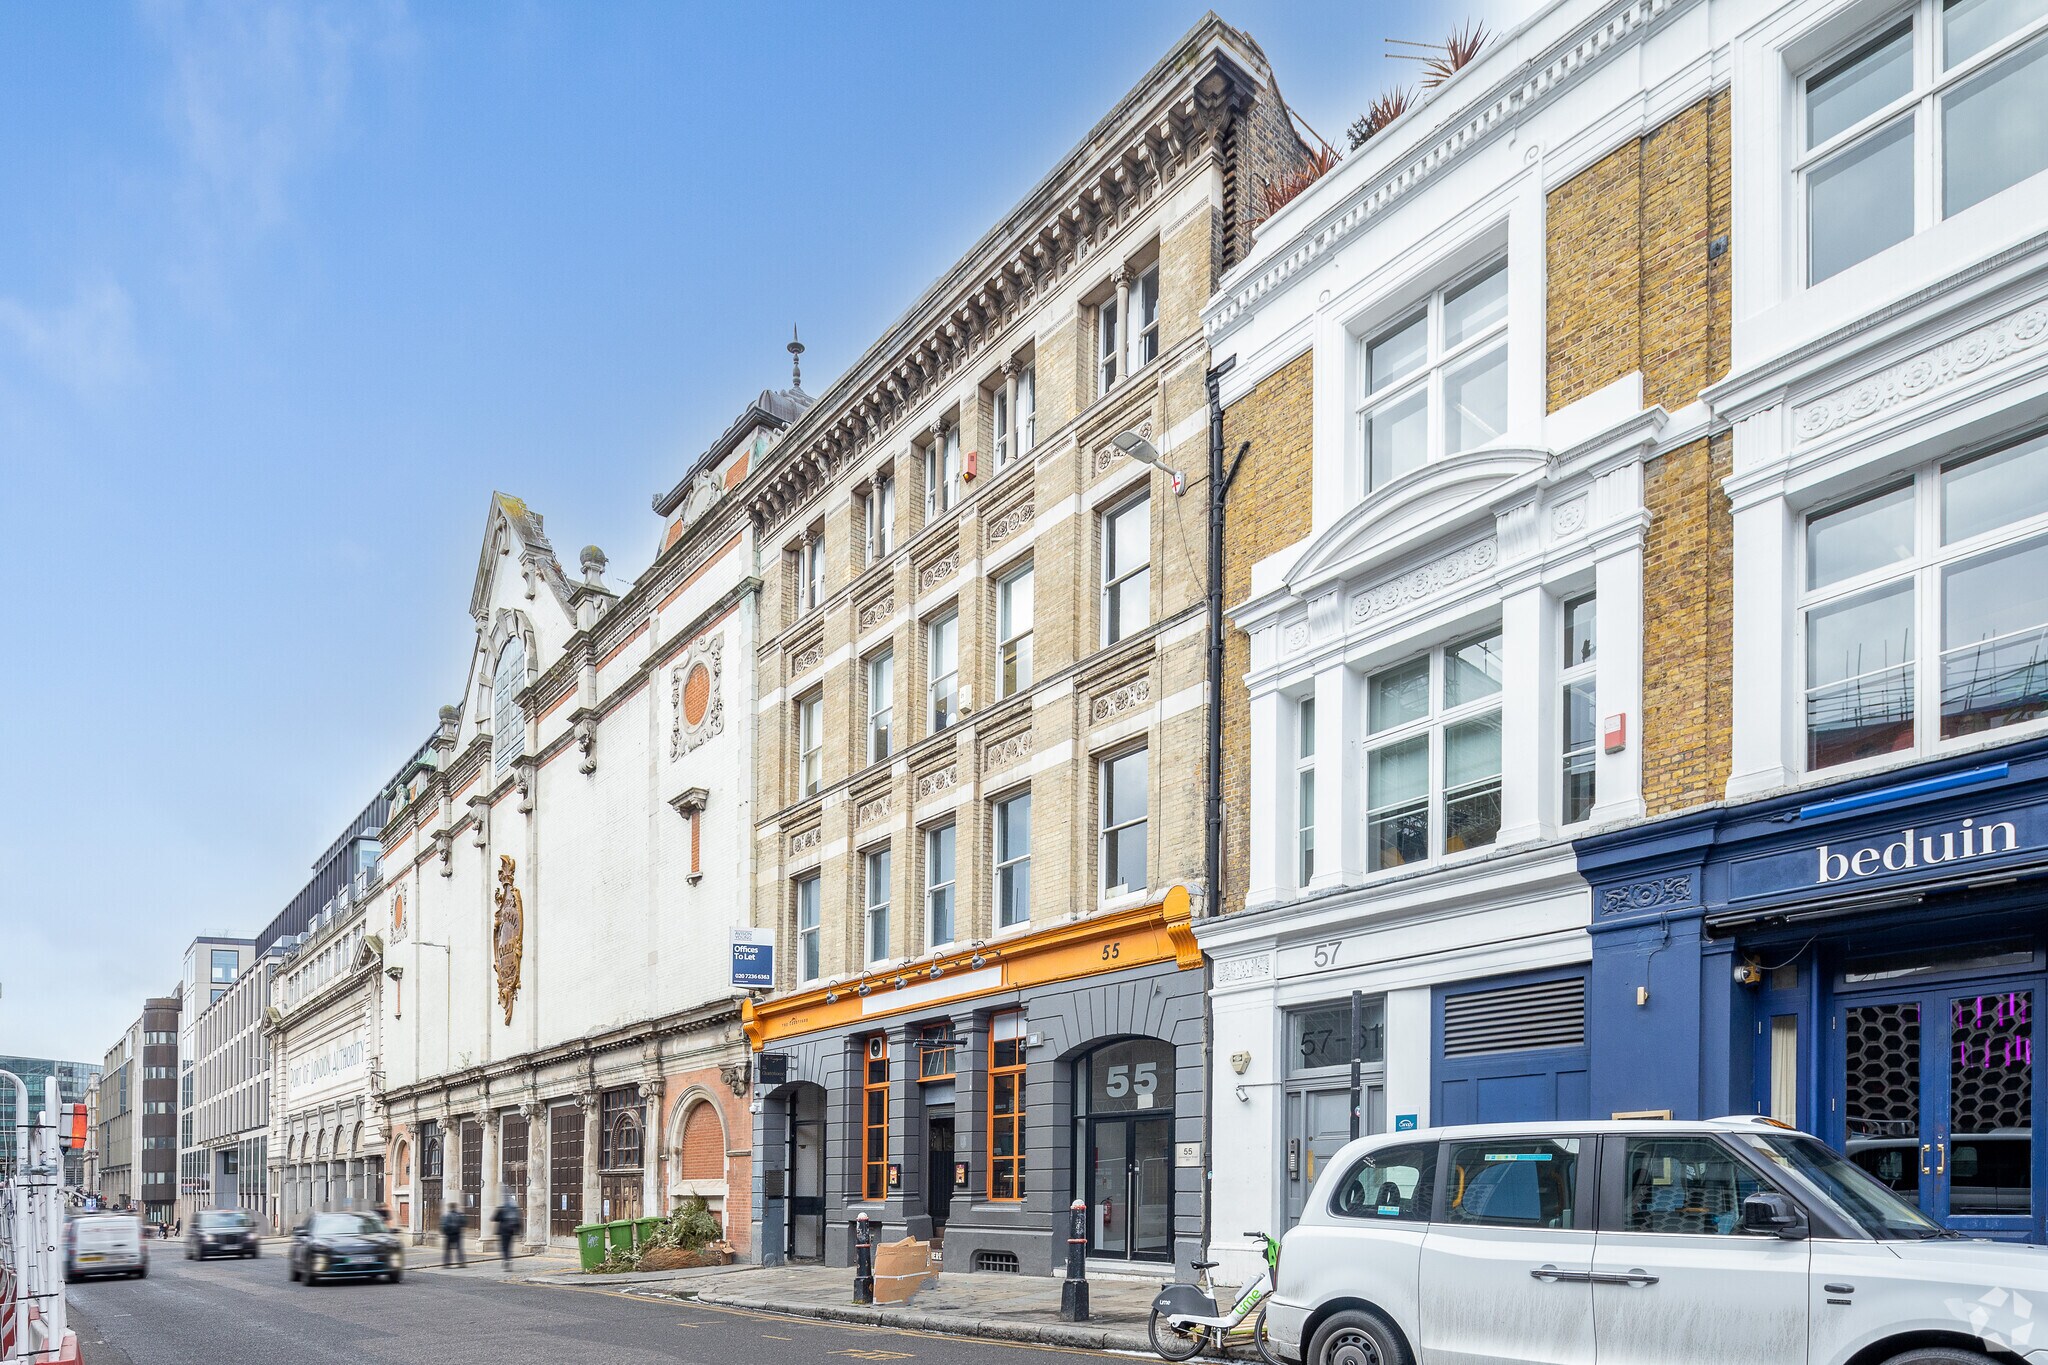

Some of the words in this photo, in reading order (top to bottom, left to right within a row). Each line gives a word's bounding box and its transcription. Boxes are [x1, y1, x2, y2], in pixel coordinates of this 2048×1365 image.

[1815, 818, 2020, 884] beduin
[734, 945, 758, 953] Offices
[1101, 942, 1120, 961] 55
[1314, 941, 1342, 968] 57
[289, 1063, 301, 1092] PORT
[311, 1056, 330, 1085] LONDON
[332, 1039, 366, 1077] AUTHORITY
[1106, 1062, 1158, 1098] 55
[1183, 1147, 1193, 1156] 55
[1235, 1289, 1262, 1315] Lime
